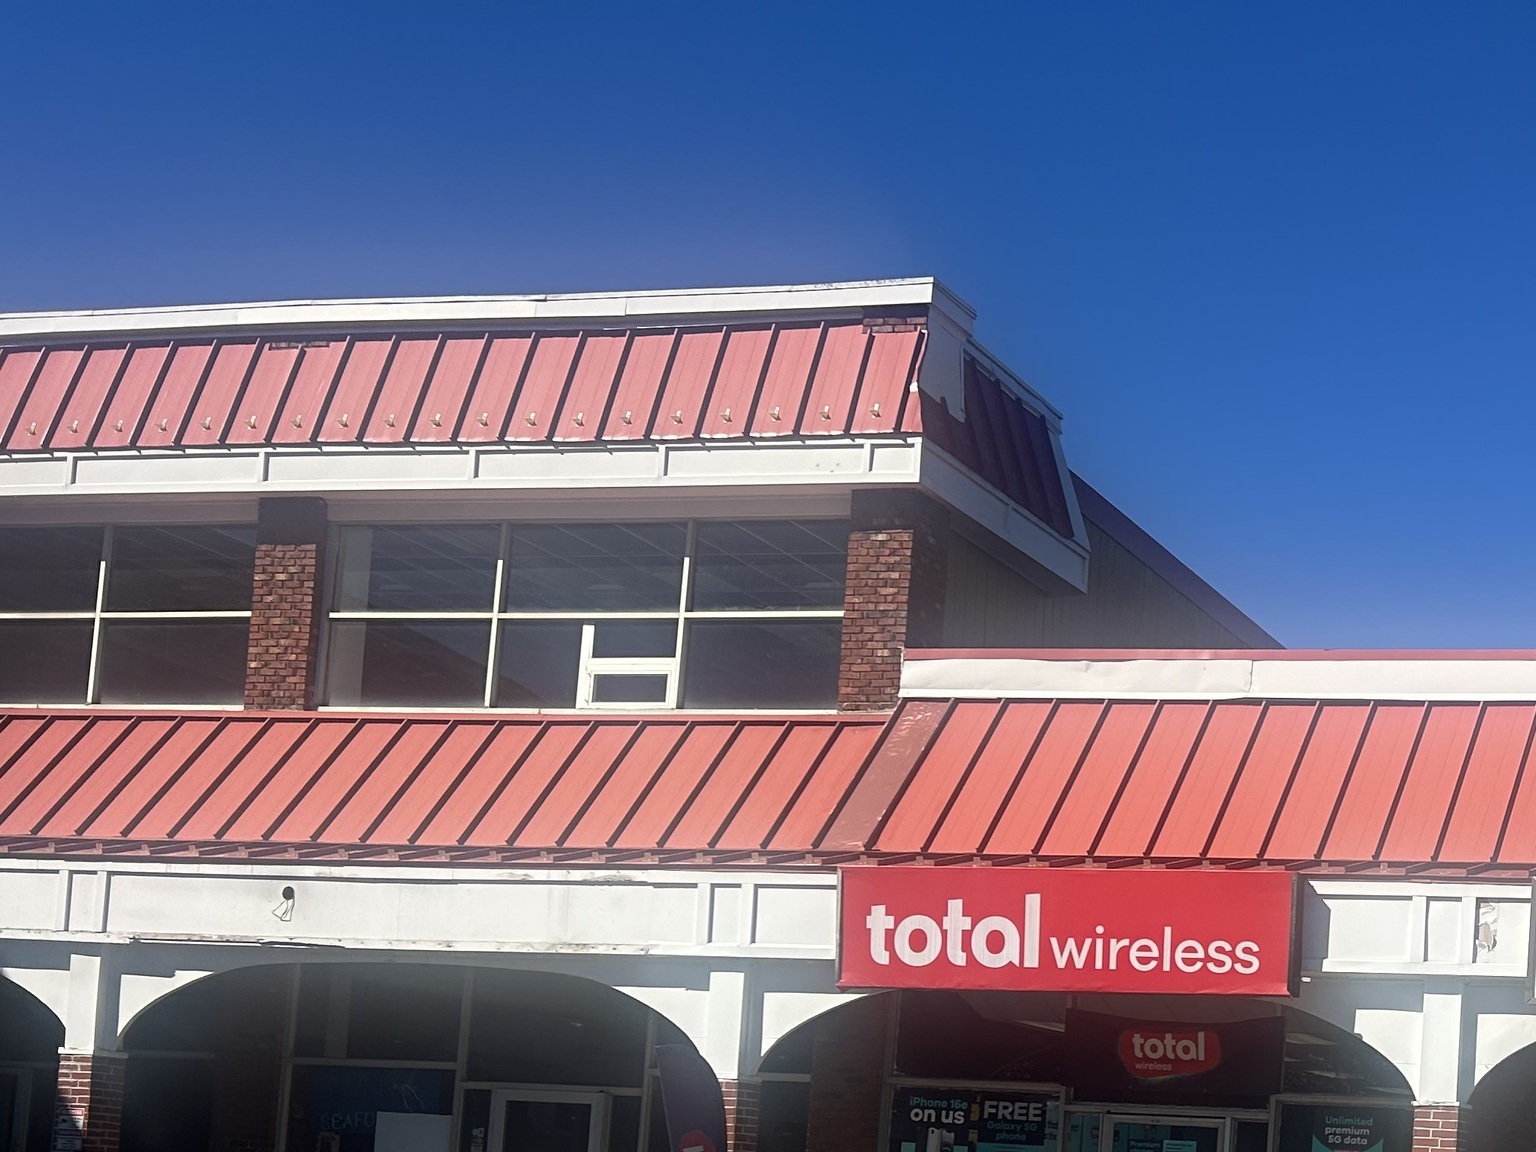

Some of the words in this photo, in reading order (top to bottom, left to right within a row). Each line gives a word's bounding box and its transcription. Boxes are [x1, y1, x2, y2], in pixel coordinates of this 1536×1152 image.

[866, 893, 1041, 969] total
[1050, 925, 1261, 974] wireless
[1132, 1031, 1205, 1061] total
[1135, 1061, 1173, 1072] wireless
[909, 1096, 947, 1109] iPhone
[950, 1099, 968, 1110] 16e
[910, 1108, 937, 1123] on
[941, 1109, 966, 1125] us
[983, 1101, 1044, 1122] FREE
[986, 1121, 1021, 1132] Galaxy
[1325, 1116, 1374, 1126] Unlimited
[1325, 1126, 1370, 1136] premium
[995, 1132, 1027, 1142] phone
[1328, 1135, 1341, 1144] 5G
[1343, 1136, 1368, 1145] data
